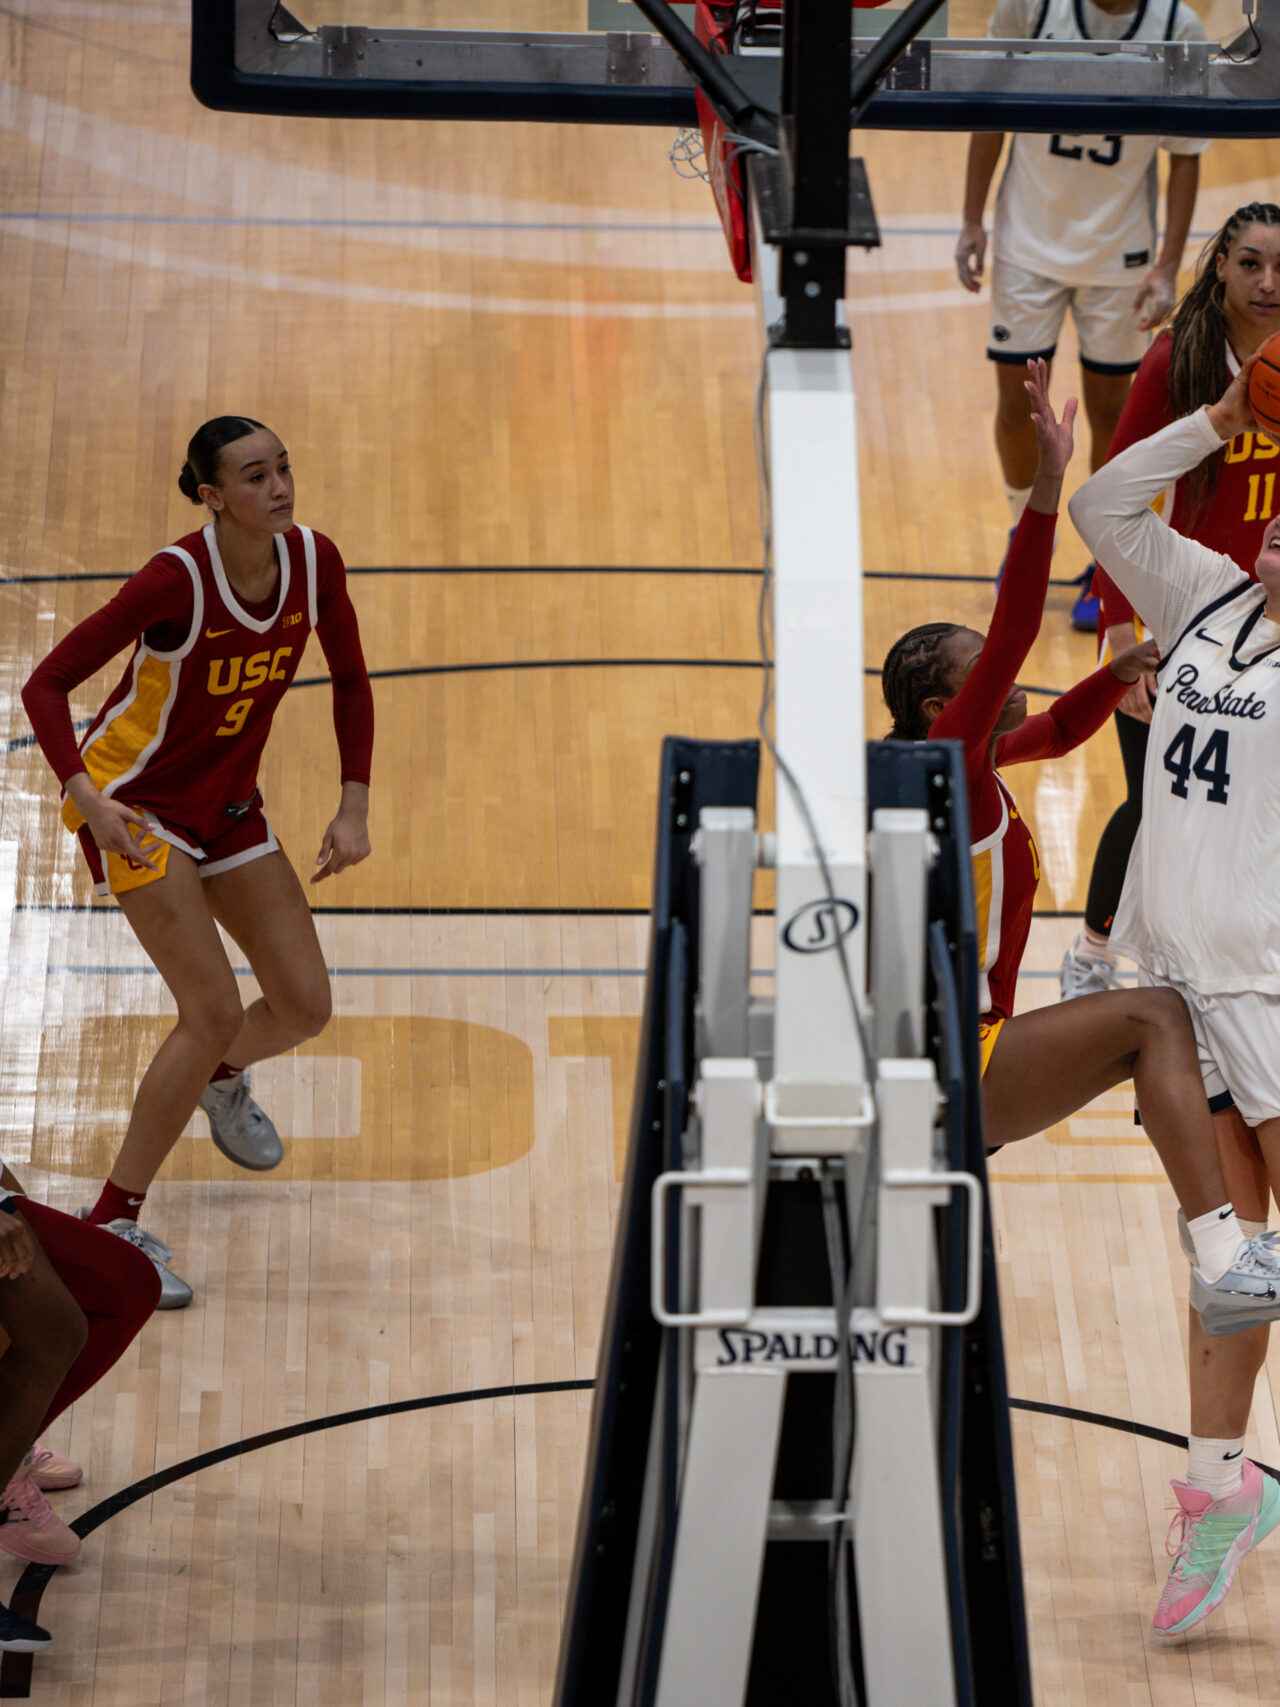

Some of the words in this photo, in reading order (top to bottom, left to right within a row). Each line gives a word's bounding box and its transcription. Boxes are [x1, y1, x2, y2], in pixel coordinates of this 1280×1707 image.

[1243, 472, 1277, 522] 11
[207, 646, 293, 696] USC
[214, 697, 255, 737] 9
[1205, 684, 1267, 720] State
[1163, 722, 1231, 806] 44
[717, 1327, 908, 1366] SPALDNG
